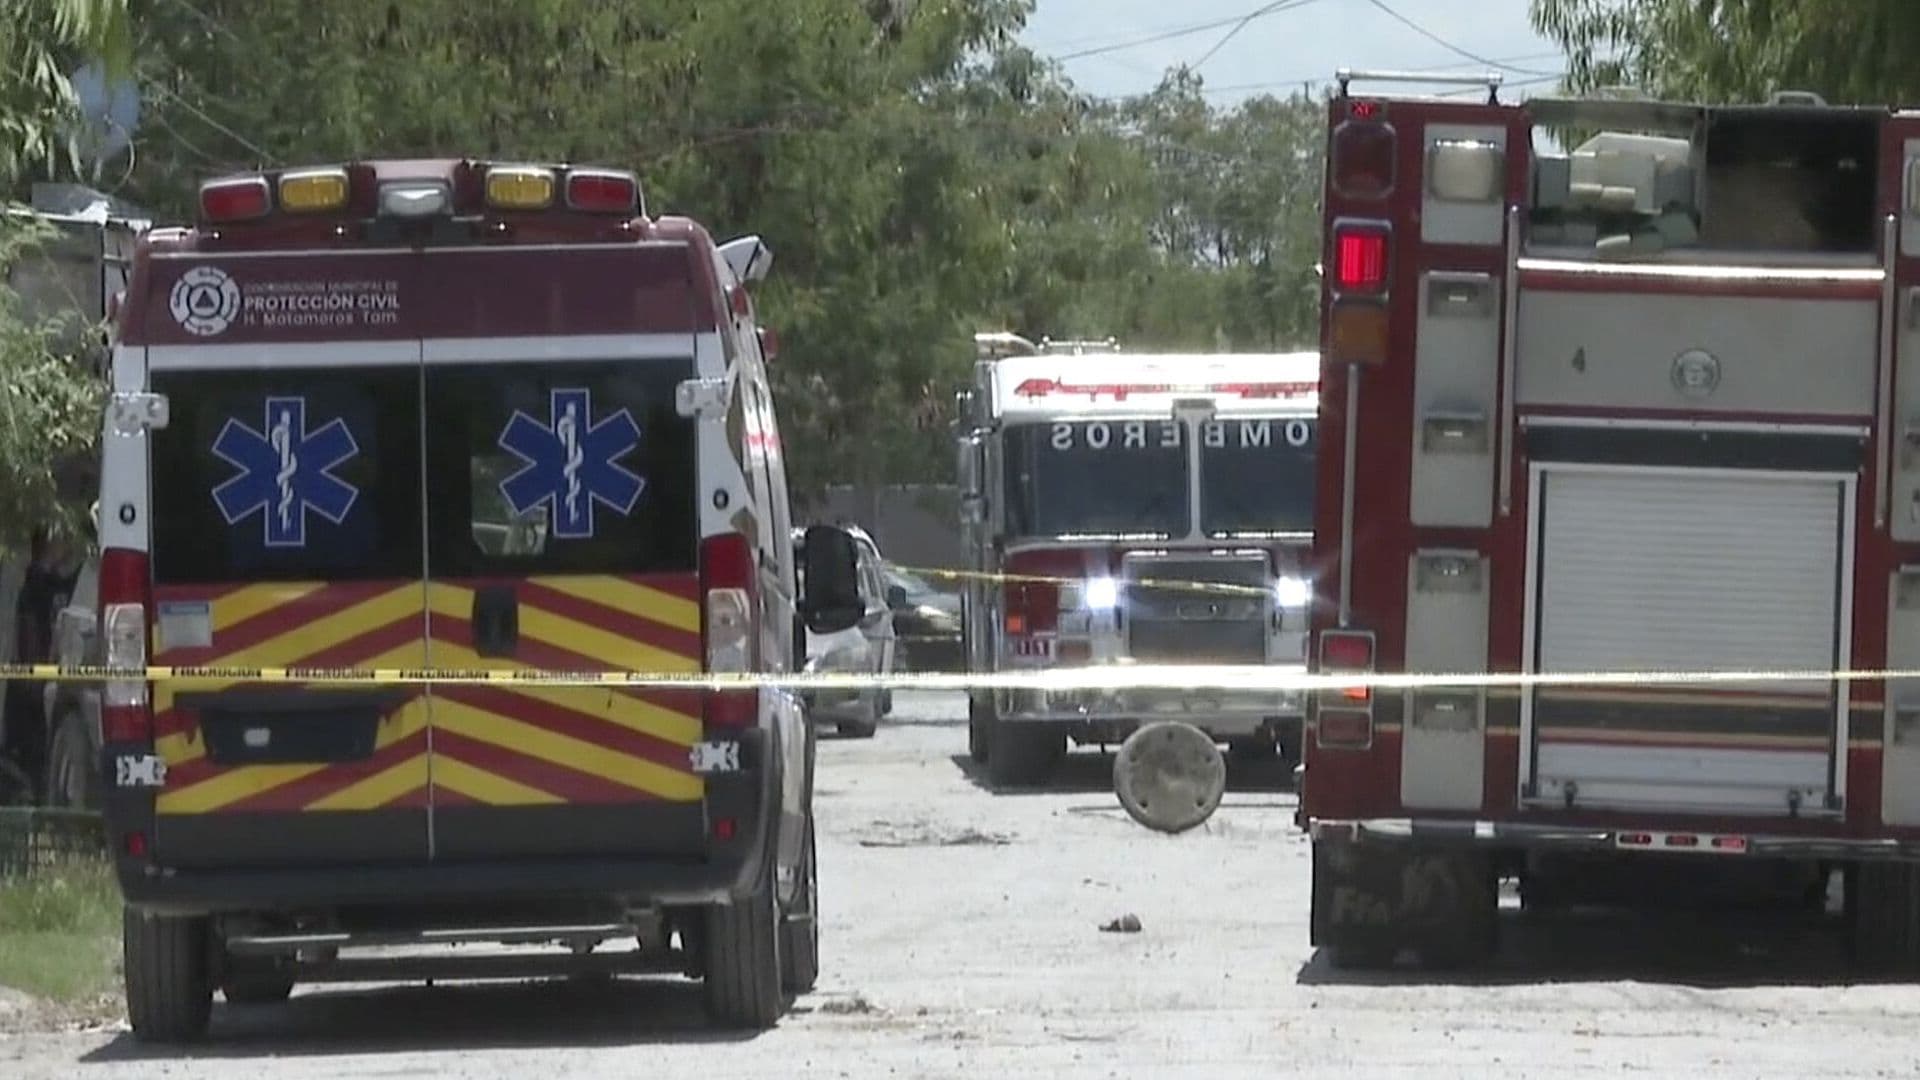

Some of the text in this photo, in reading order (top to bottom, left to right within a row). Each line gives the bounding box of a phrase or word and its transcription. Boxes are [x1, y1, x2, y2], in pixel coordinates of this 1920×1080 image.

[244, 292, 400, 310] PROTECCIÓN CIVIL
[264, 311, 353, 325] Matamoros
